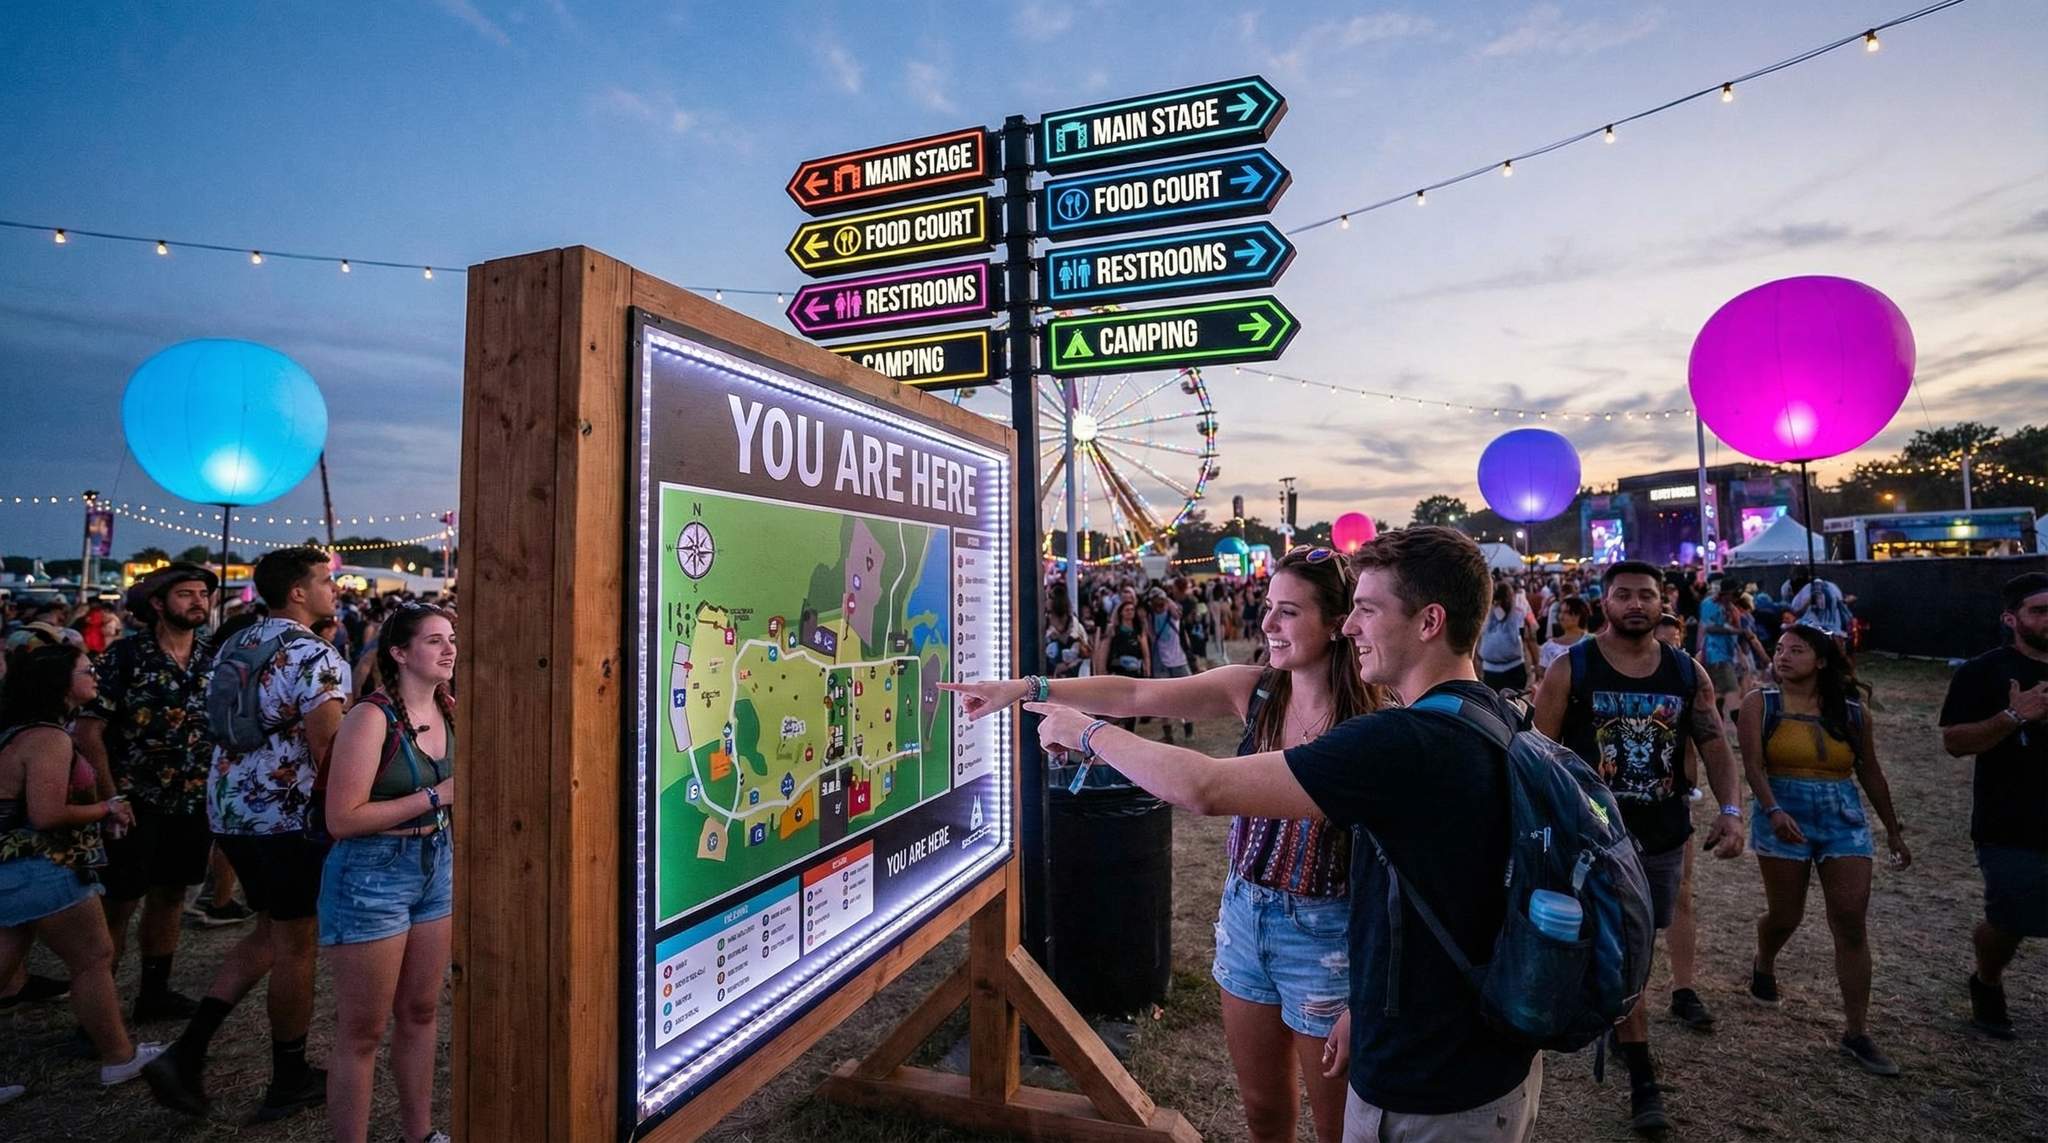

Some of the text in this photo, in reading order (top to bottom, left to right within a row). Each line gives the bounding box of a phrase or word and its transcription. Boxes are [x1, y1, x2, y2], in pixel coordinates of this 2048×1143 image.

[1093, 98, 1219, 146] MAIN STAGE
[865, 142, 972, 186] MAIN STAGE
[1094, 170, 1222, 214] FOOD COURT
[865, 208, 974, 250] FOOD COURT
[1097, 242, 1227, 285] RESTROOMS
[865, 274, 976, 314] RESTROOMS
[1100, 319, 1198, 355] CAMPING
[728, 394, 977, 516] YOU ARE HERE
[692, 502, 702, 516] N
[692, 583, 698, 593] S
[887, 848, 907, 877] YOU
[908, 838, 927, 866] ARE
[928, 825, 950, 854] HERE
